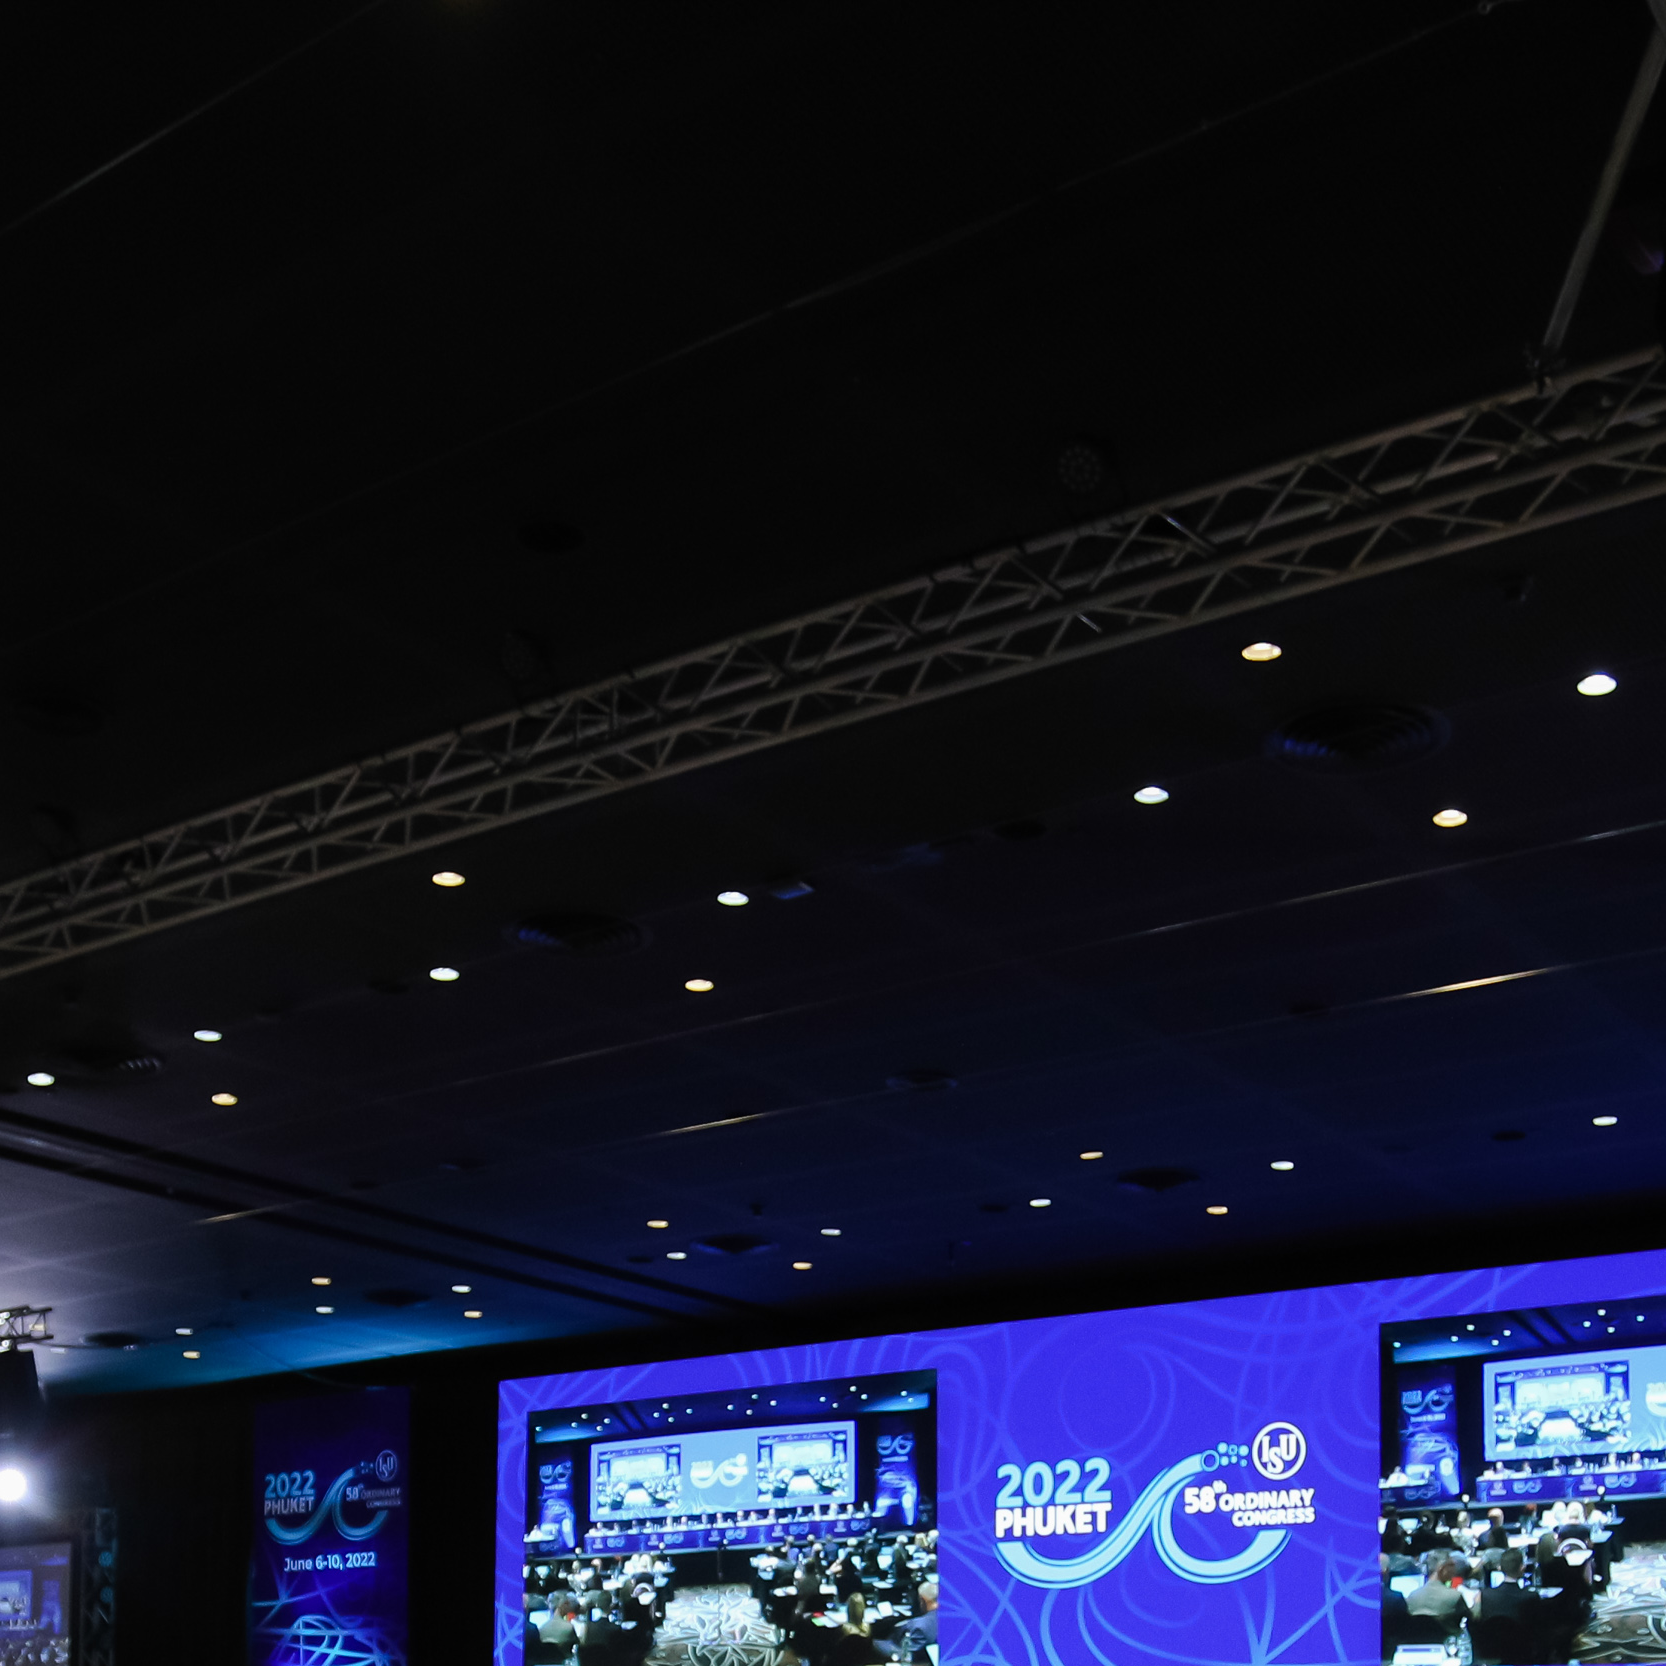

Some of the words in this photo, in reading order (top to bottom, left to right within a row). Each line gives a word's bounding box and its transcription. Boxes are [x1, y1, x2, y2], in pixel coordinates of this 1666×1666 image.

[264, 1469, 316, 1499] 2022
[996, 1456, 1112, 1507] 2022
[264, 1496, 315, 1516] PHUKET
[1219, 1488, 1315, 1512] ORDINARY
[995, 1502, 1112, 1537] PHUKET
[1232, 1506, 1316, 1528] CONGRESS
[284, 1557, 313, 1572] June
[315, 1553, 344, 1571] 6-10,
[345, 1551, 378, 1569] 2022
